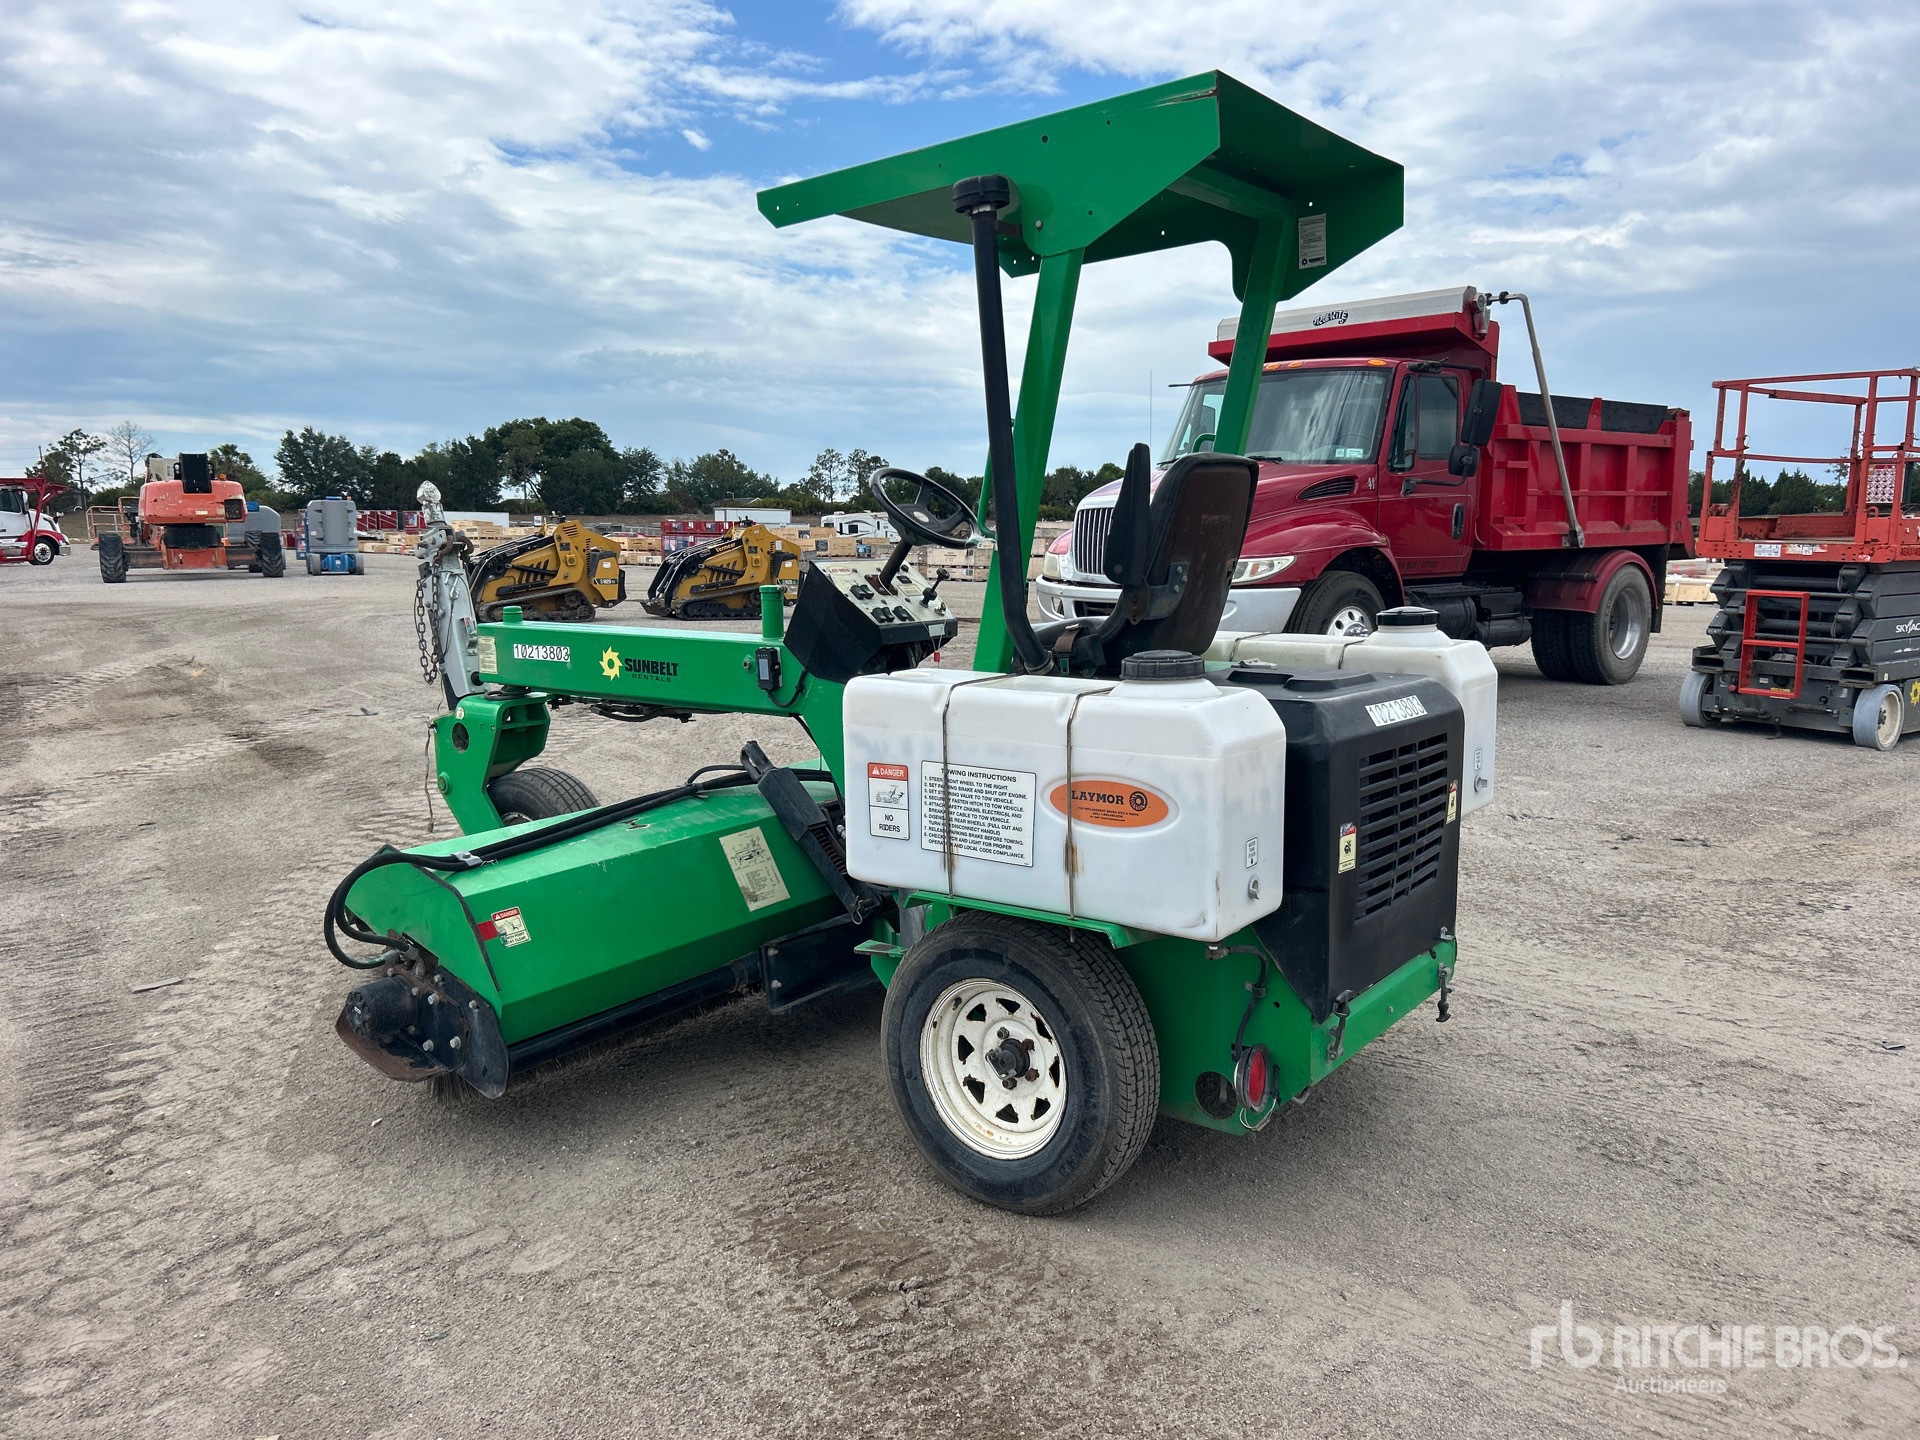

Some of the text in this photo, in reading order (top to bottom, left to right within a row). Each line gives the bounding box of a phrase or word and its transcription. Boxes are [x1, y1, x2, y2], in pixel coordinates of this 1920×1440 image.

[514, 645, 569, 661] 10213803
[625, 658, 678, 676] SUNBELT
[632, 674, 671, 682] RENTALS
[1369, 696, 1425, 724] 10213803
[880, 768, 904, 777] DANGER
[941, 768, 1016, 782] TWING INSTRUCTIONS
[1071, 791, 1124, 805] LAYMOR
[982, 809, 1010, 817] ELECTRICAL
[879, 824, 900, 832] RIDERS
